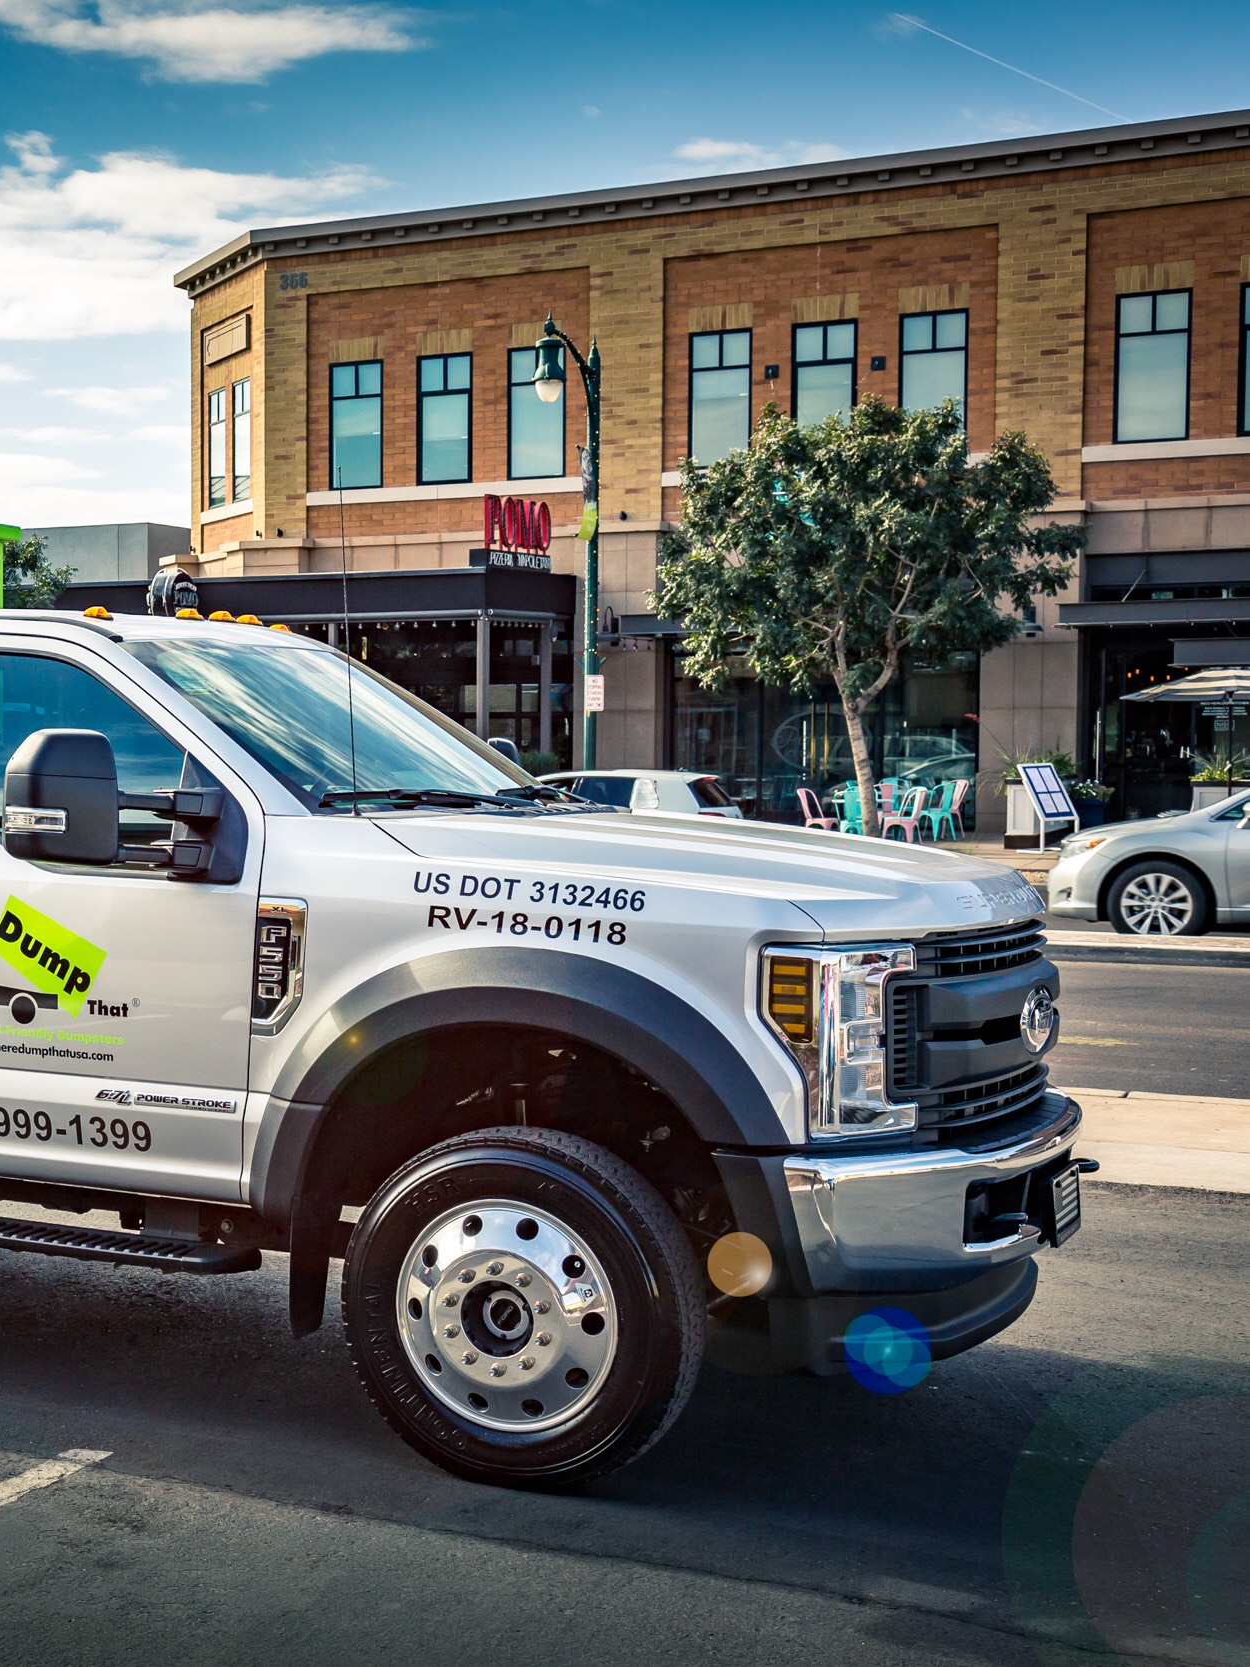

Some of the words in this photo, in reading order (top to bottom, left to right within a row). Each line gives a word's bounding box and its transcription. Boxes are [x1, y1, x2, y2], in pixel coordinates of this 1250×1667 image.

[279, 271, 309, 291] 366
[484, 493, 551, 551] POMO
[489, 552, 514, 567] PIZZERIA
[173, 590, 199, 607] POMO
[413, 871, 451, 895] US
[459, 874, 521, 900] DOT
[529, 881, 647, 912] 3132466
[427, 905, 628, 946] RV-18-0118
[258, 925, 287, 1000] F550
[87, 1000, 129, 1018] That
[5, 1025, 54, 1041] Friendly
[57, 1029, 125, 1046] Dumpsters
[136, 1093, 179, 1105] POWER
[181, 1097, 232, 1109] STROKE
